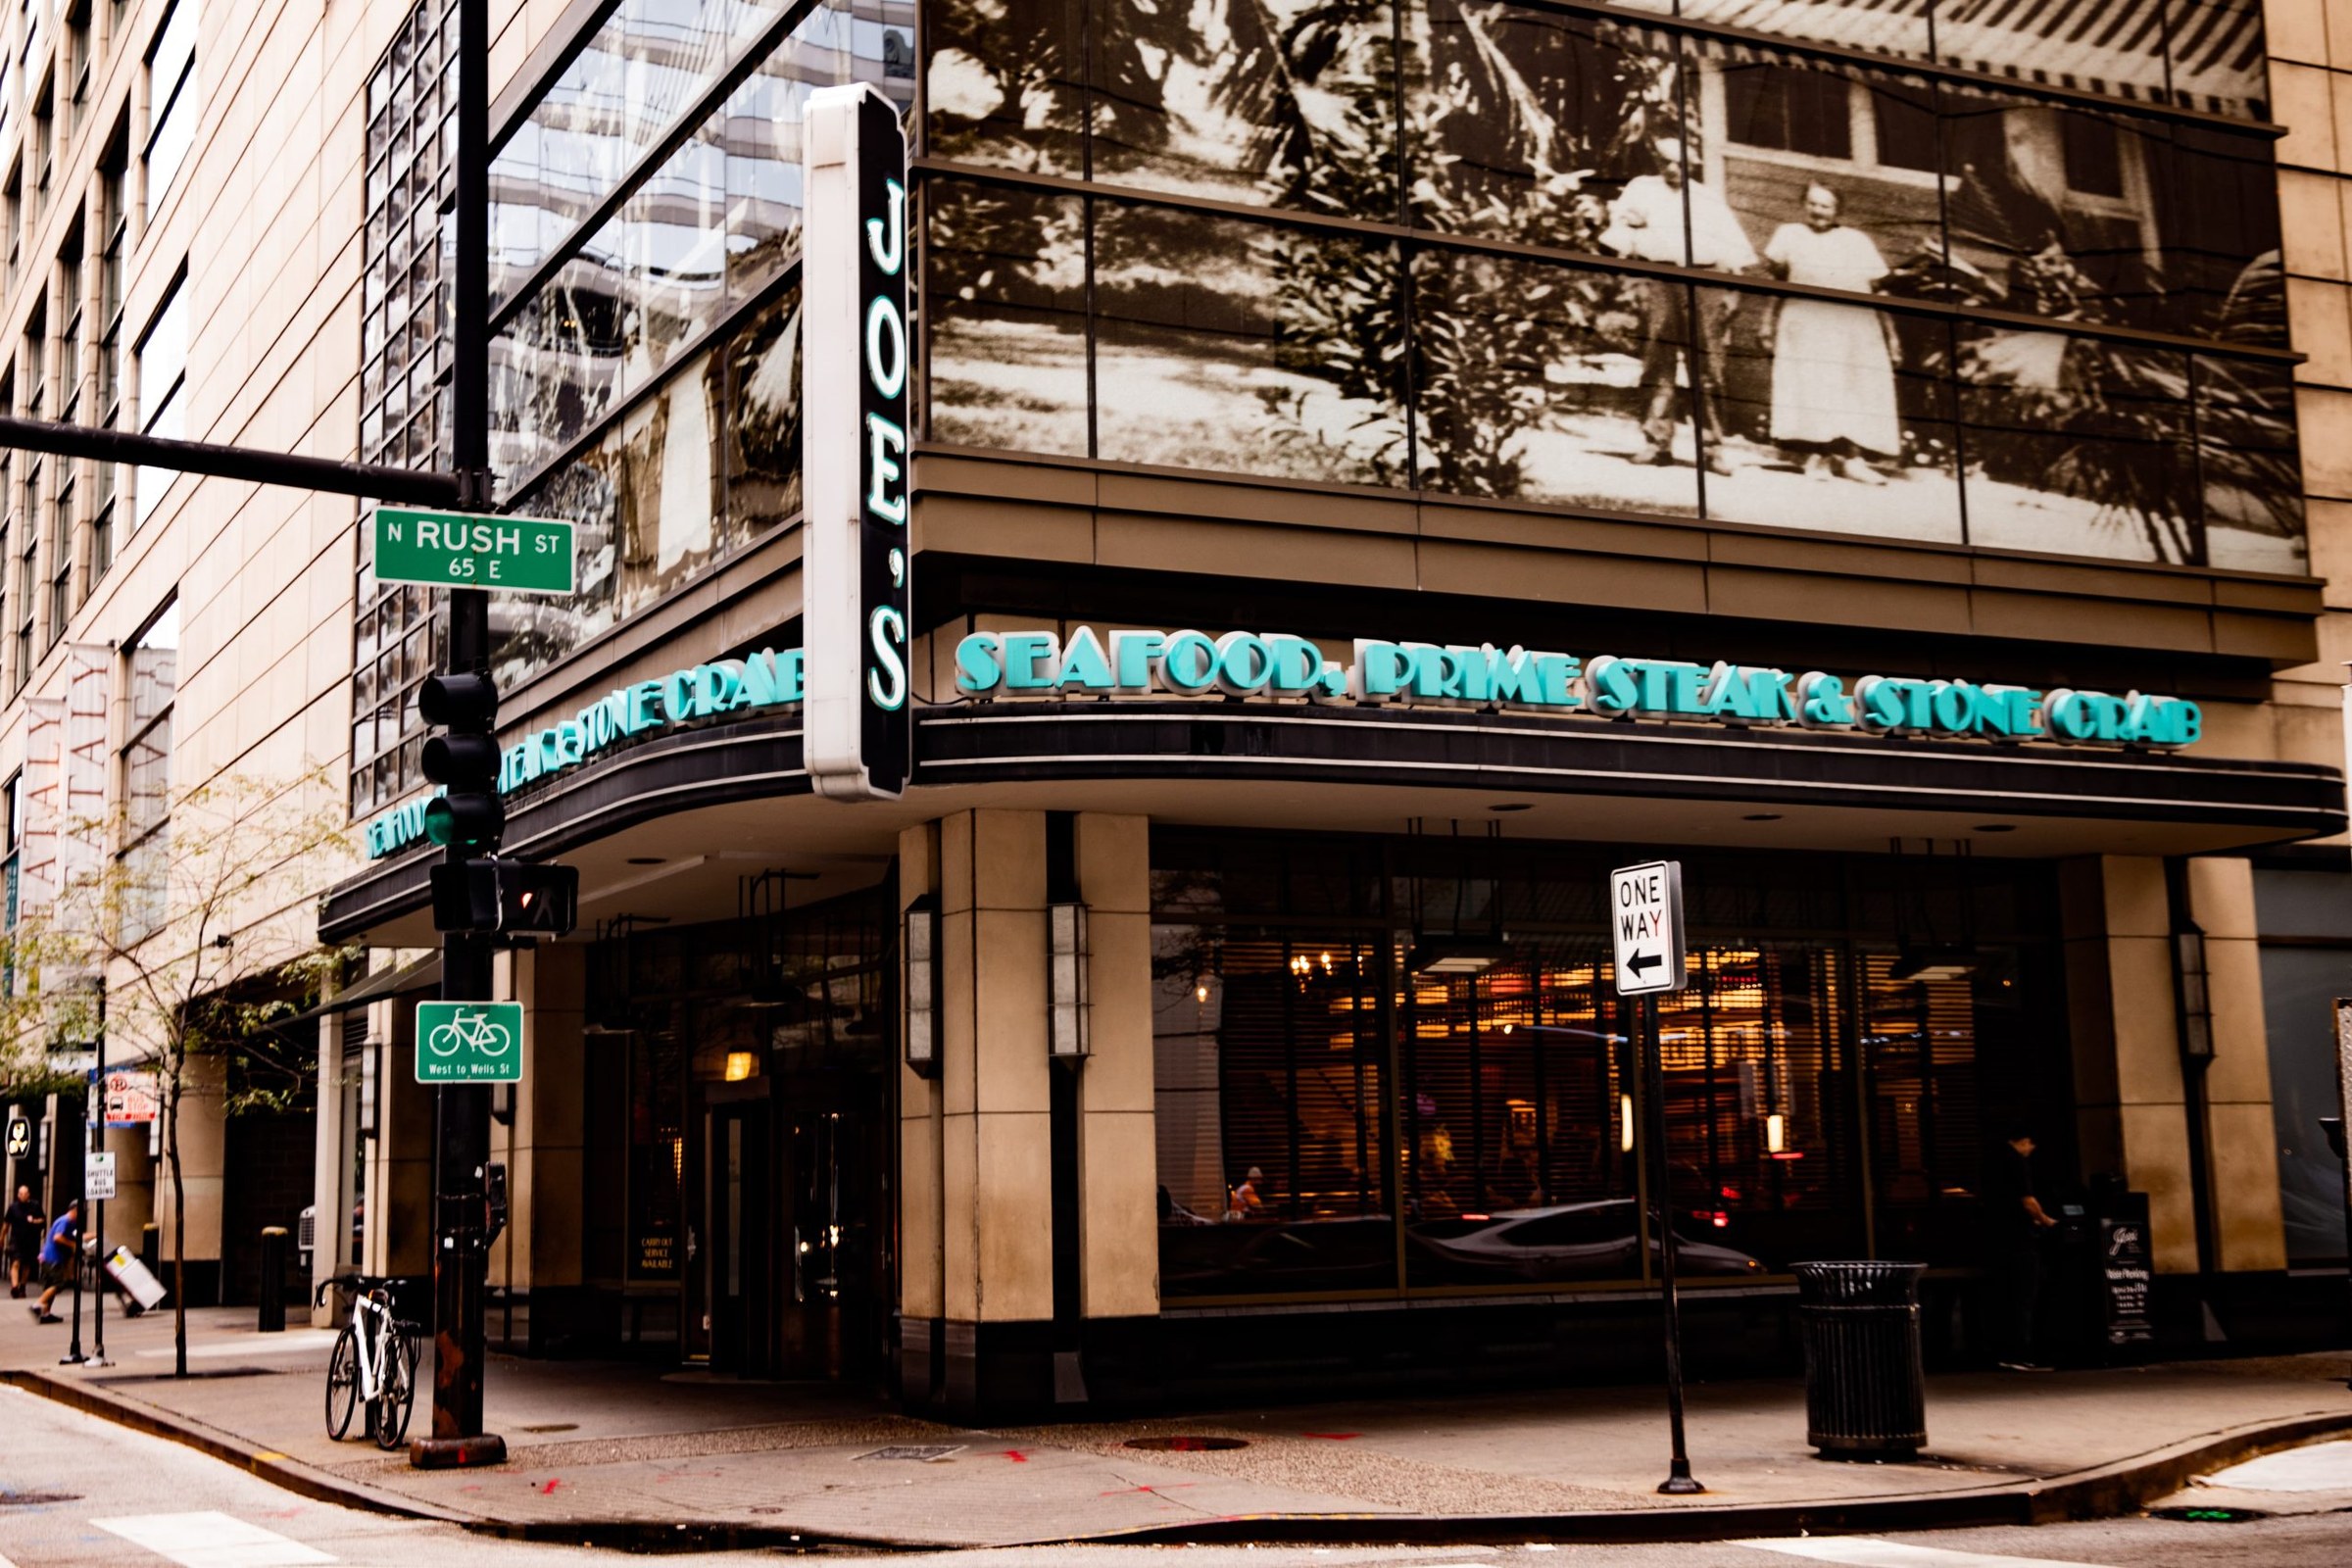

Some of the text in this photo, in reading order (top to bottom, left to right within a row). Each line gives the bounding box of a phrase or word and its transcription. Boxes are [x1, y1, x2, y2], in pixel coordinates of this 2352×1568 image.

[866, 178, 906, 711] JOE'S
[388, 520, 560, 556] N RUSH ST
[449, 558, 502, 579] 65 E
[1353, 638, 1582, 708] PRIME
[1587, 656, 1793, 720] STEAK
[1798, 671, 1855, 729] &
[1855, 675, 2044, 743] STONE
[2043, 688, 2203, 750] CRAB
[497, 728, 561, 796] TEAK
[575, 679, 664, 756] STONE
[21, 706, 61, 921] EATALY
[1620, 875, 1660, 907] ONE
[1620, 909, 1662, 941] WAY
[429, 1063, 510, 1074] West to Wells St
[87, 1168, 114, 1178] SHUTTLE
[86, 1187, 114, 1196] LOADING
